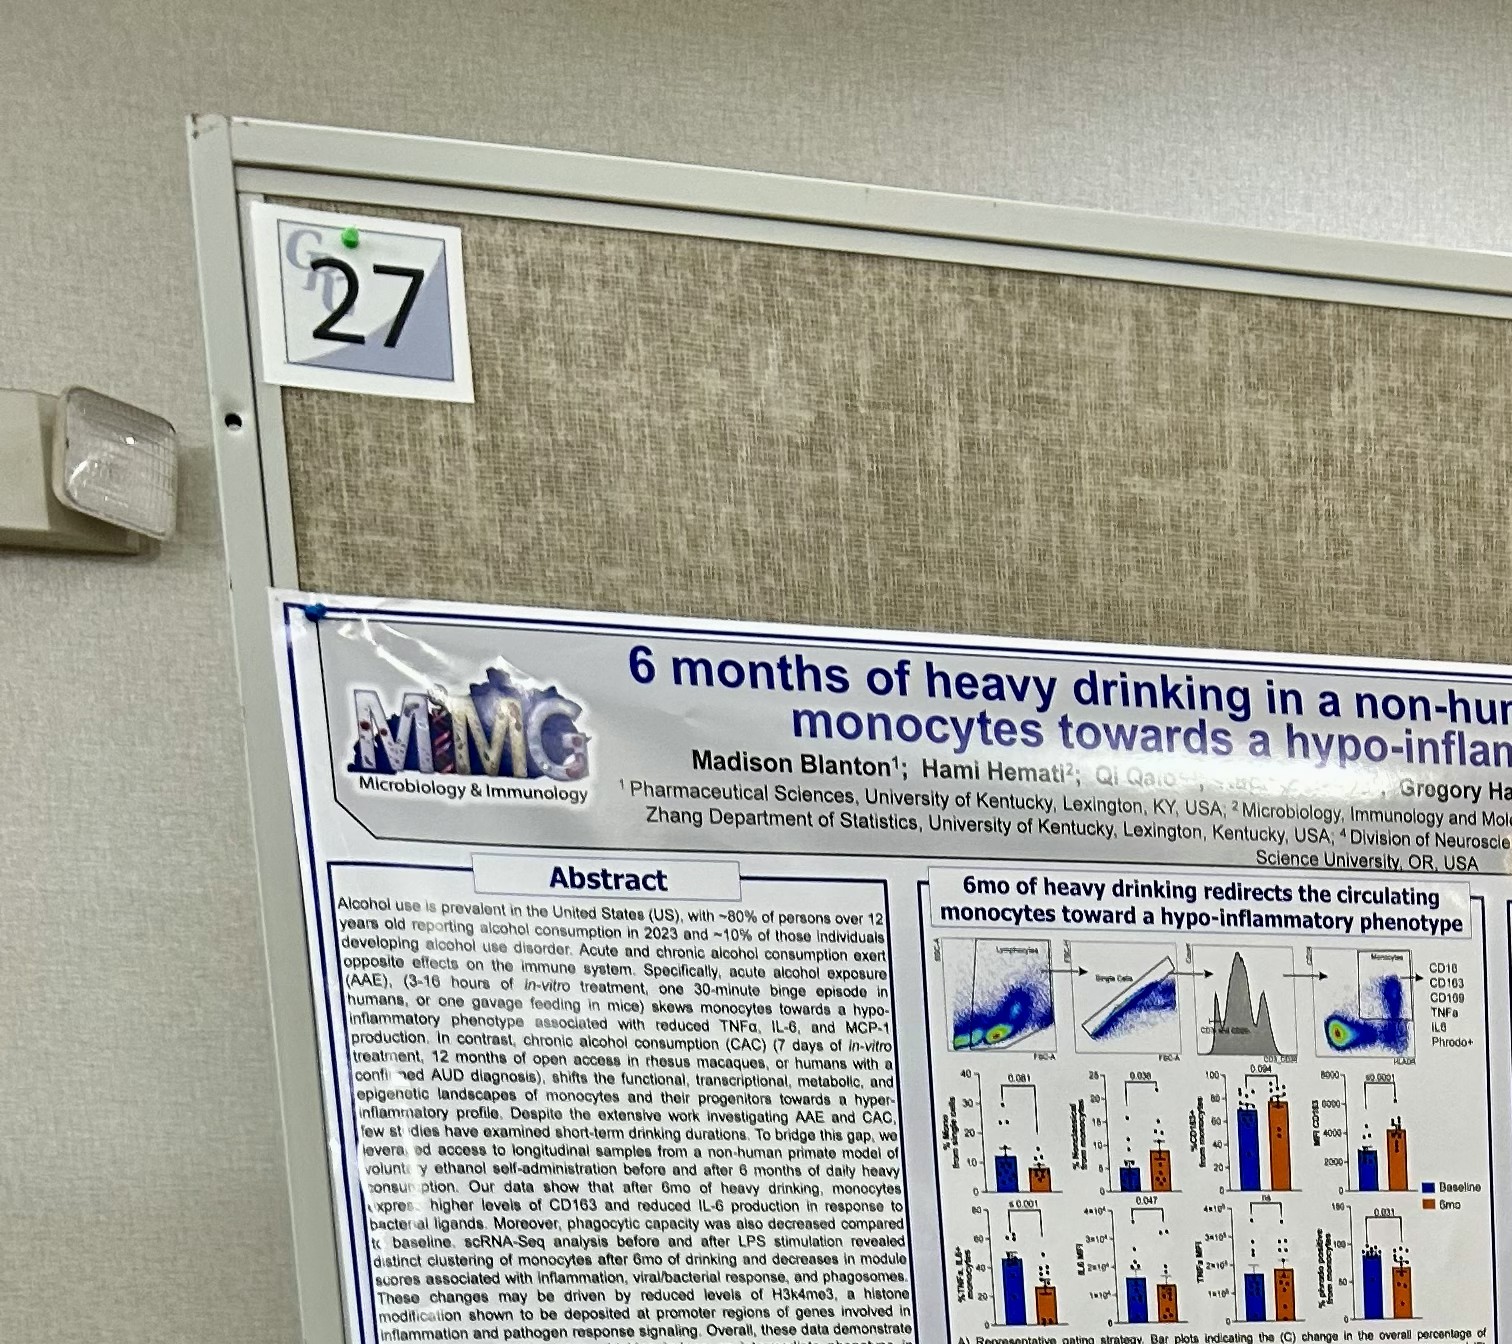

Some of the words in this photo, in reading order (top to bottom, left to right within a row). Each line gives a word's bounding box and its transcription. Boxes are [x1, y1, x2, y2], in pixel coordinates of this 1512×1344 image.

[310, 256, 425, 349] 27
[629, 644, 656, 684] 6
[671, 651, 850, 694] months
[866, 649, 911, 697] of
[925, 661, 1058, 712] heavy
[1073, 669, 1251, 722] drinking
[1266, 676, 1304, 715] in
[1318, 673, 1341, 718] a
[792, 709, 1044, 752] monocytes
[1057, 713, 1233, 756] towards
[1248, 716, 1271, 757] a
[692, 749, 793, 774] Madison
[922, 750, 980, 780] Hami
[359, 770, 467, 800] Microbiology
[470, 782, 483, 798] &
[486, 783, 588, 805] Immunology
[630, 780, 769, 802] Pharmaceutical
[774, 784, 859, 807] Sciences,
[865, 787, 950, 811] University
[954, 791, 972, 808] of
[976, 791, 1057, 815] Kentucky,
[1063, 795, 1148, 817] Lexington,
[1153, 798, 1179, 817] KY,
[1185, 799, 1227, 819] USA;
[1399, 779, 1483, 805] Gregory
[549, 867, 669, 891] Abstract
[1256, 849, 1319, 871] Science
[1324, 851, 1403, 874] University,
[1408, 853, 1438, 875] OR,
[1443, 854, 1479, 876] USA
[963, 875, 1010, 896] 6mo
[1016, 876, 1038, 896] of
[1043, 876, 1106, 902] heavy
[1111, 878, 1197, 904] drinking
[1203, 882, 1293, 902] redirects
[1297, 884, 1332, 904] the
[1336, 886, 1440, 909] circulating
[940, 904, 1056, 926] monocytes
[1061, 904, 1137, 925] toward
[1142, 910, 1155, 925] a
[1160, 906, 1354, 934] hypo-inflammatory
[1360, 911, 1463, 936] phenotype
[1439, 1181, 1482, 1193] Baseline
